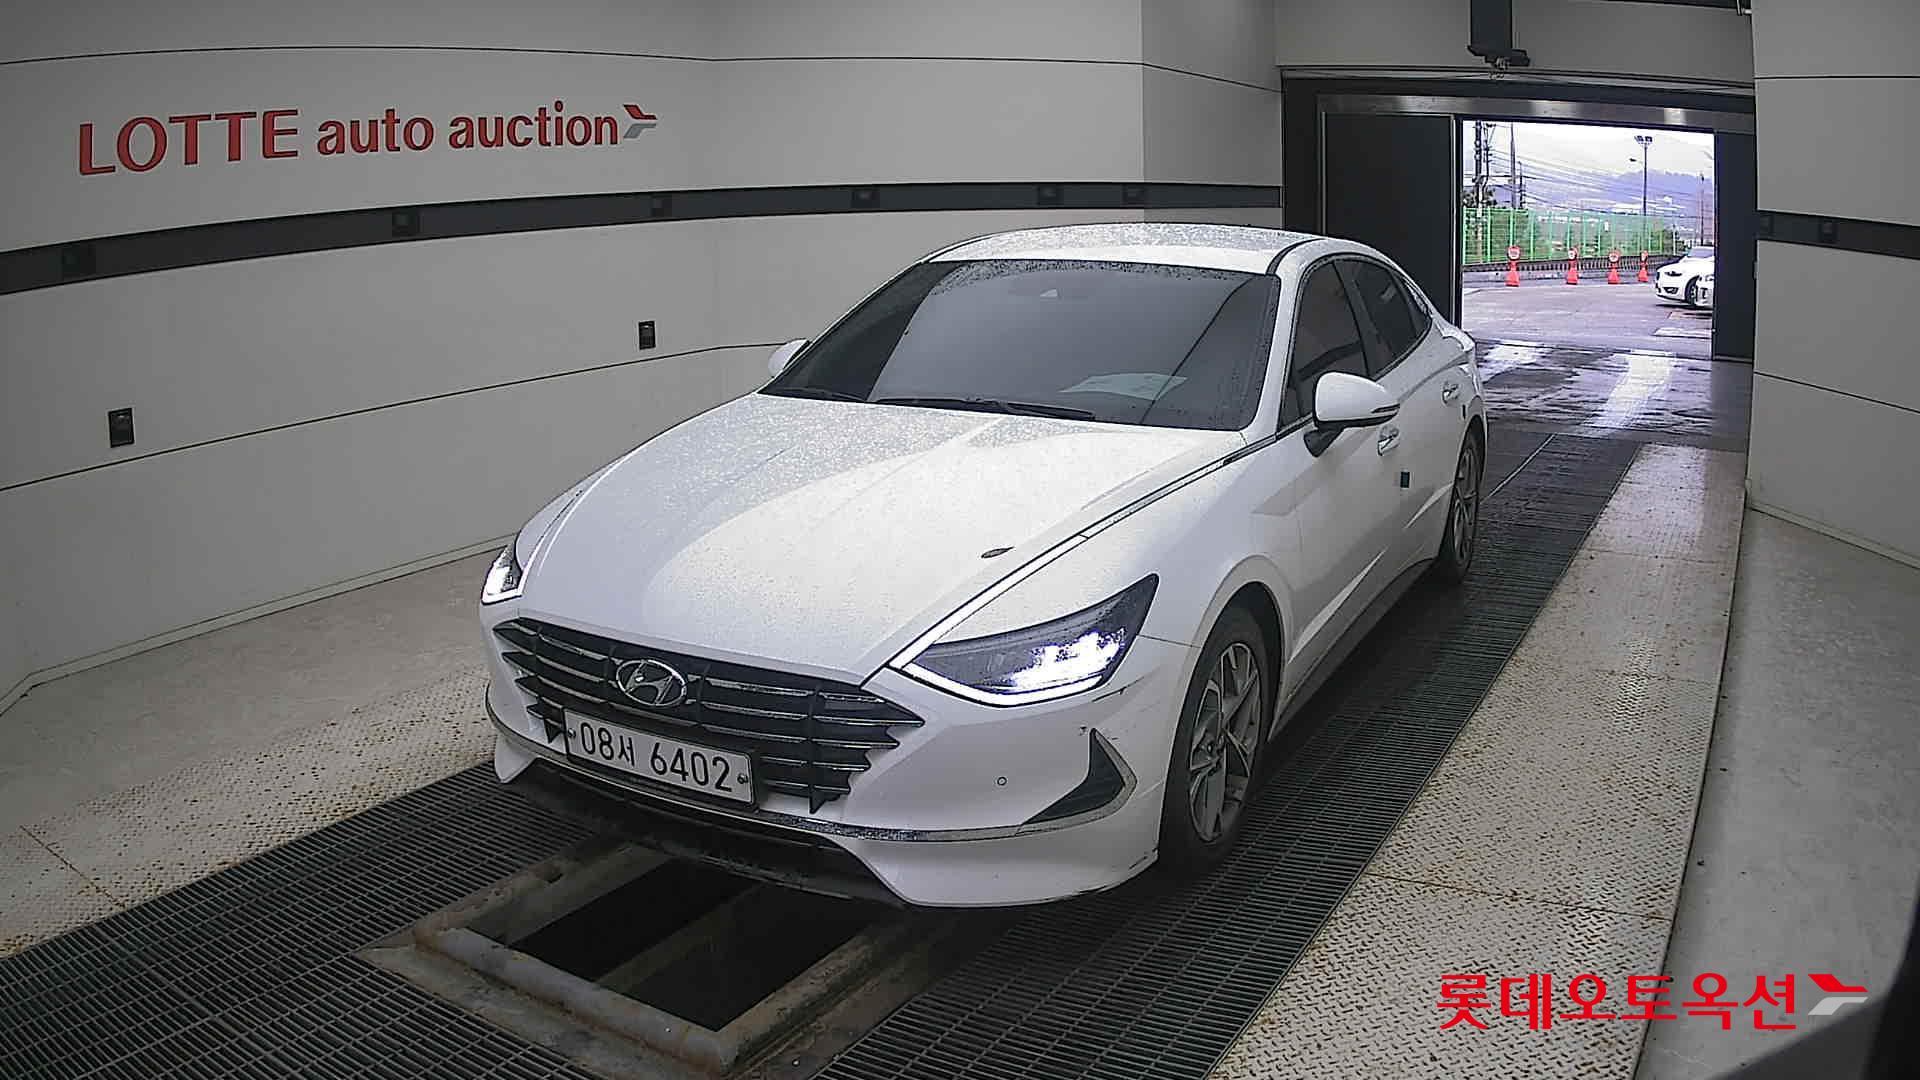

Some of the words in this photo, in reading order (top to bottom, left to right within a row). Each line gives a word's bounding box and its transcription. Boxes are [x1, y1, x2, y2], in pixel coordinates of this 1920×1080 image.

[79, 108, 299, 175] LOTTE
[316, 108, 434, 156] auto
[448, 100, 619, 150] auction
[580, 722, 635, 767] 08서
[650, 742, 733, 793] 6402
